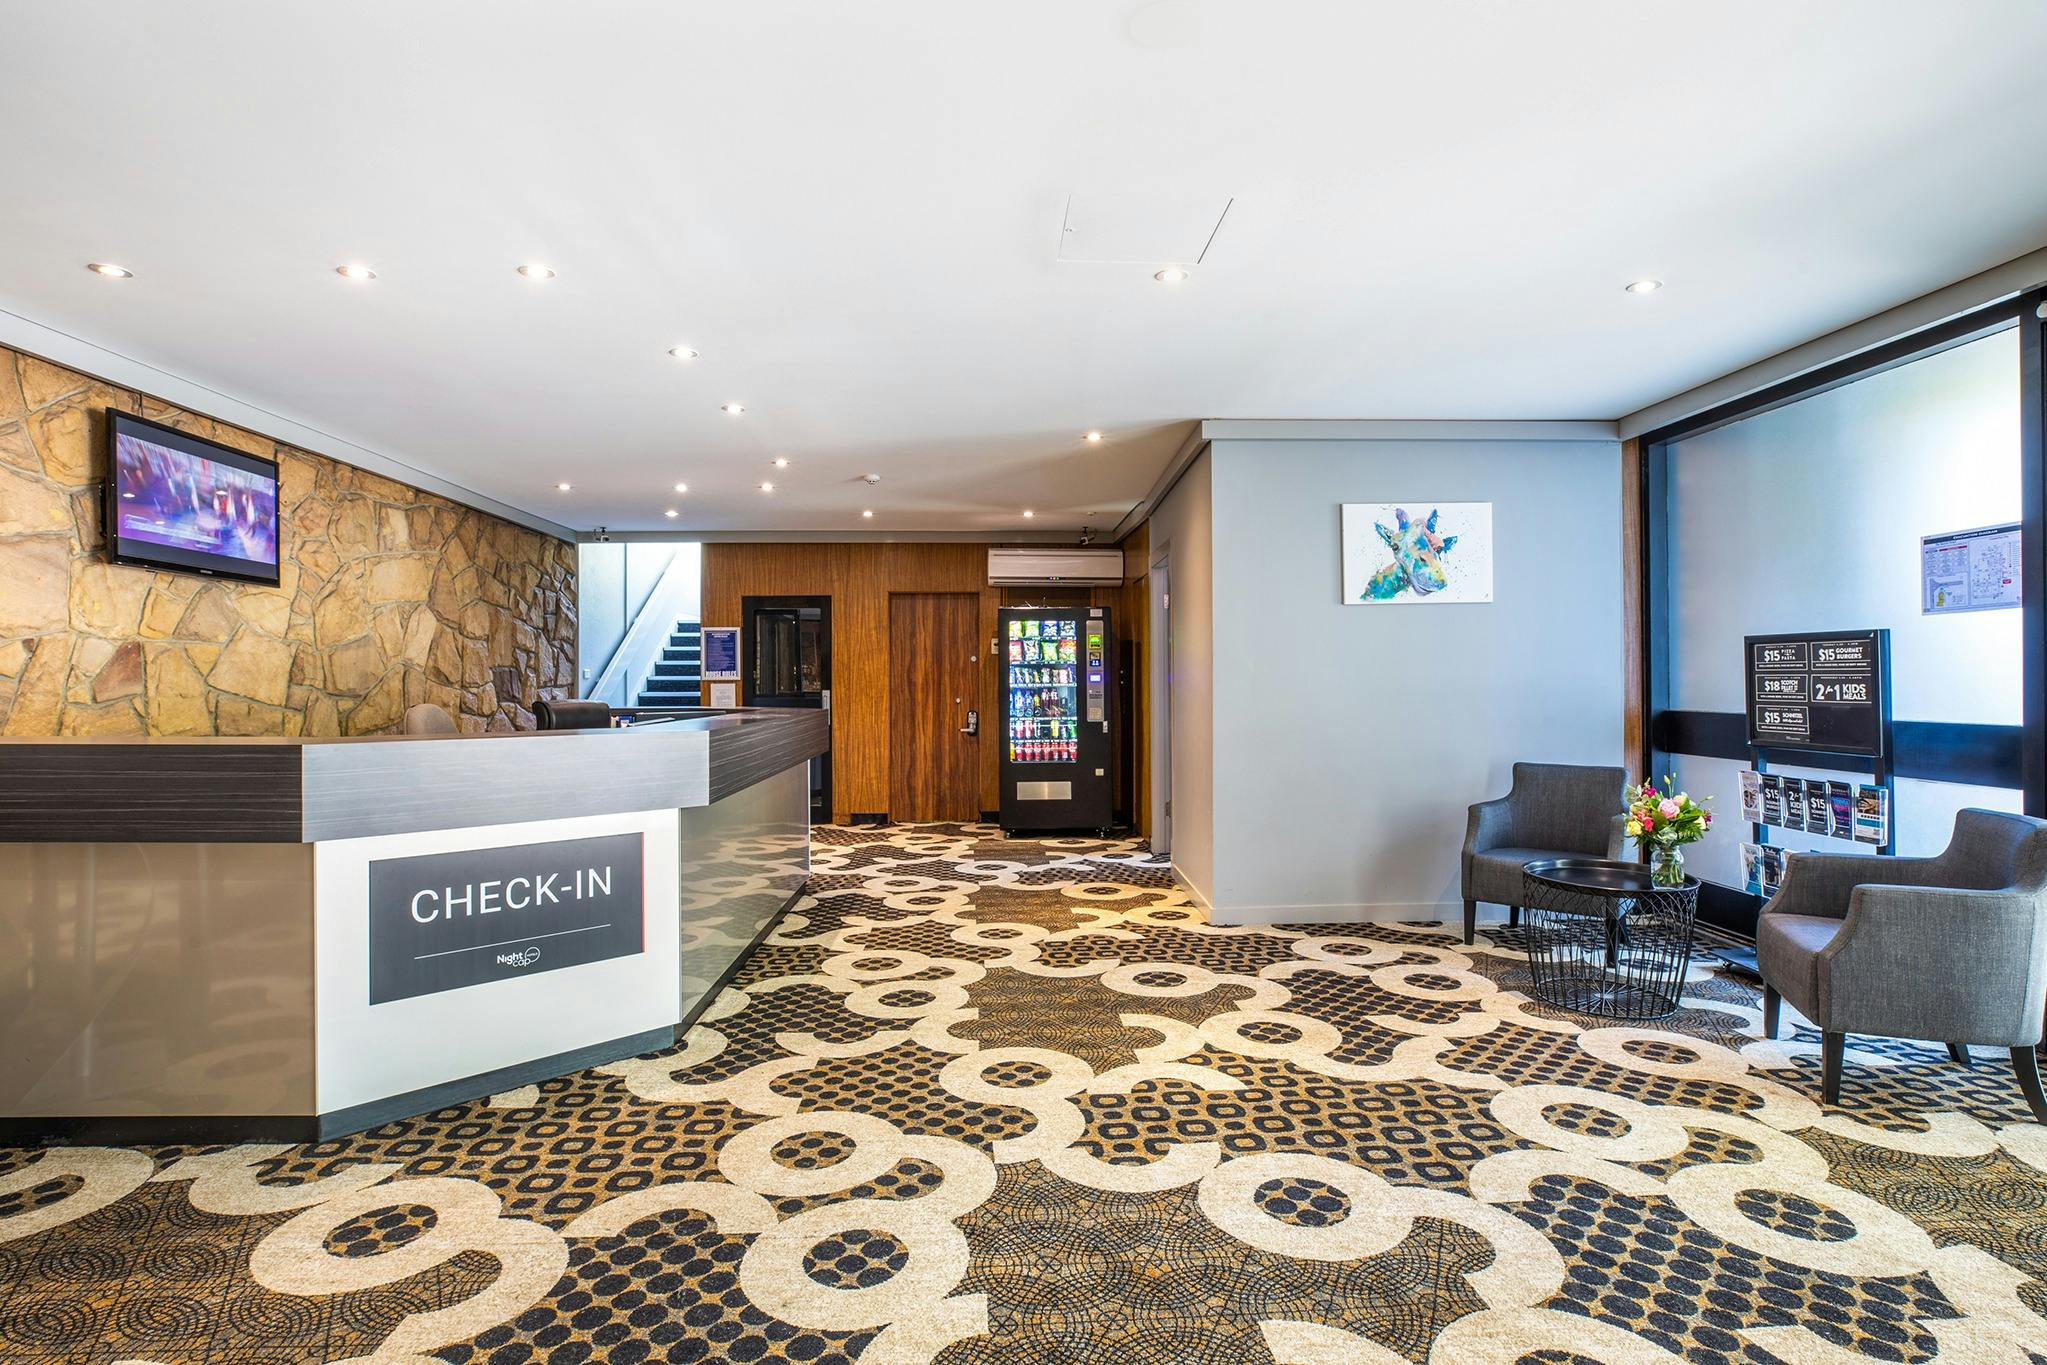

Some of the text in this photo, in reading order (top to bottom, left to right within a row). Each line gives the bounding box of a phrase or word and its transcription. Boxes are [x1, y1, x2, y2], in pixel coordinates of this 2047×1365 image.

[1764, 649, 1780, 663] $15
[1818, 648, 1836, 662] $15
[1764, 680, 1780, 692] $18
[1815, 683, 1825, 700] 2
[1833, 684, 1840, 701] 1
[1842, 683, 1866, 693] KIDS
[1842, 692, 1867, 700] MEALS
[1764, 711, 1780, 724] $15
[1765, 788, 1780, 799] $15
[1810, 797, 1826, 809] $15
[411, 866, 612, 924] CHECK-IN
[496, 952, 523, 965] Night
[512, 958, 531, 967] cap
